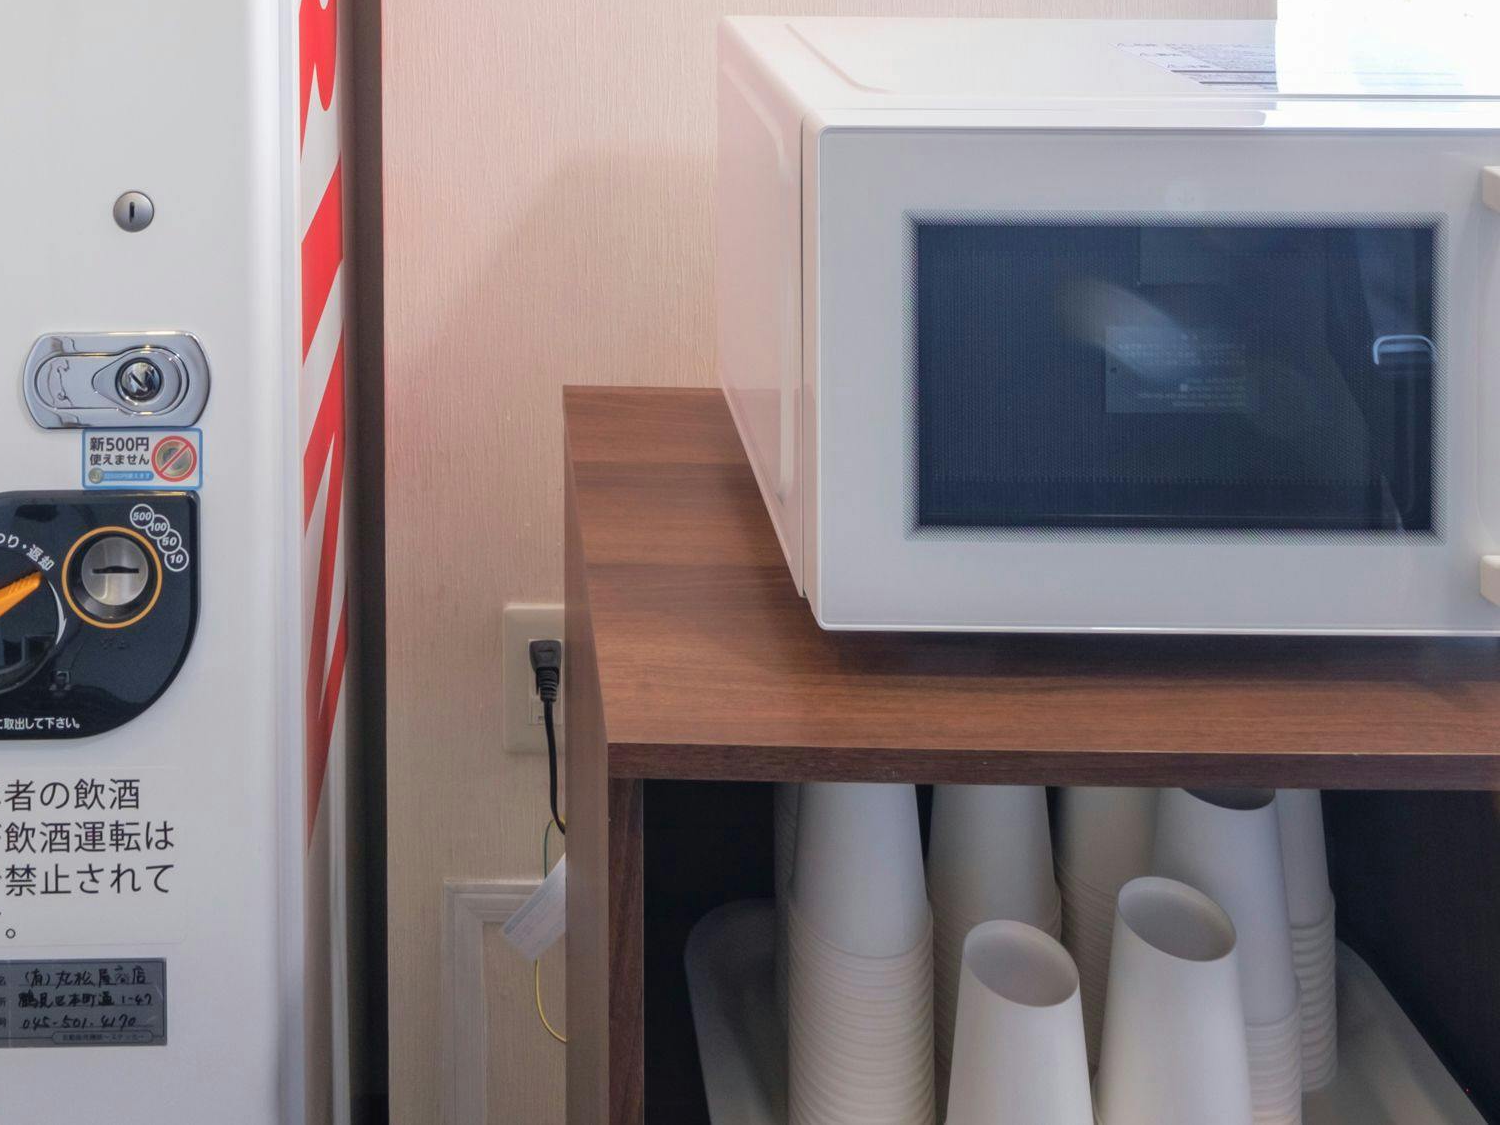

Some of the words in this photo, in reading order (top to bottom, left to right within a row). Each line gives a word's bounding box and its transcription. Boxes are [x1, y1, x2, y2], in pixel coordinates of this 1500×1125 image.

[90, 437, 150, 452] 新500円
[90, 453, 150, 466] 使えません
[133, 511, 152, 522] 500
[150, 522, 167, 531] 100
[162, 537, 177, 546] 50
[170, 554, 184, 564] 10
